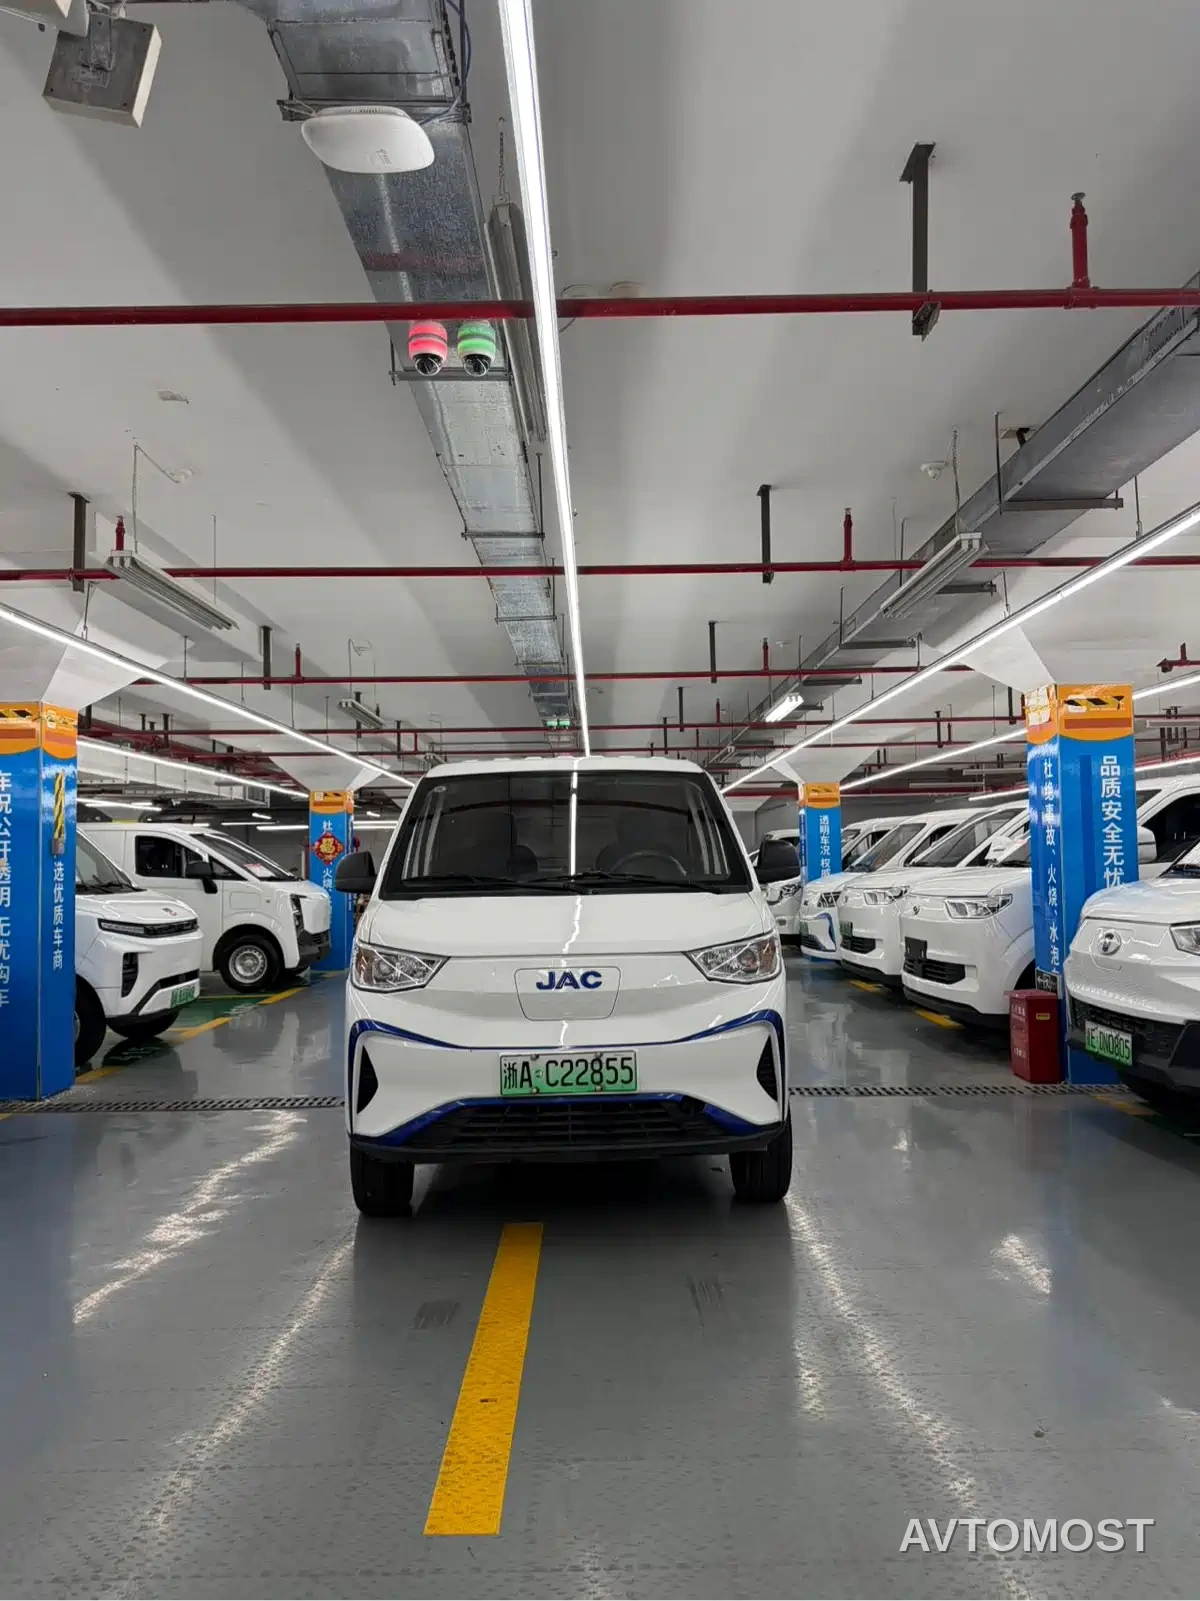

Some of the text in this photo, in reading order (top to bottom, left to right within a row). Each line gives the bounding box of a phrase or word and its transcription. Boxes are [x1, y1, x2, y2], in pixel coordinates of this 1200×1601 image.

[1101, 755, 1125, 888] 品质安全无忧
[536, 970, 603, 990] JAC
